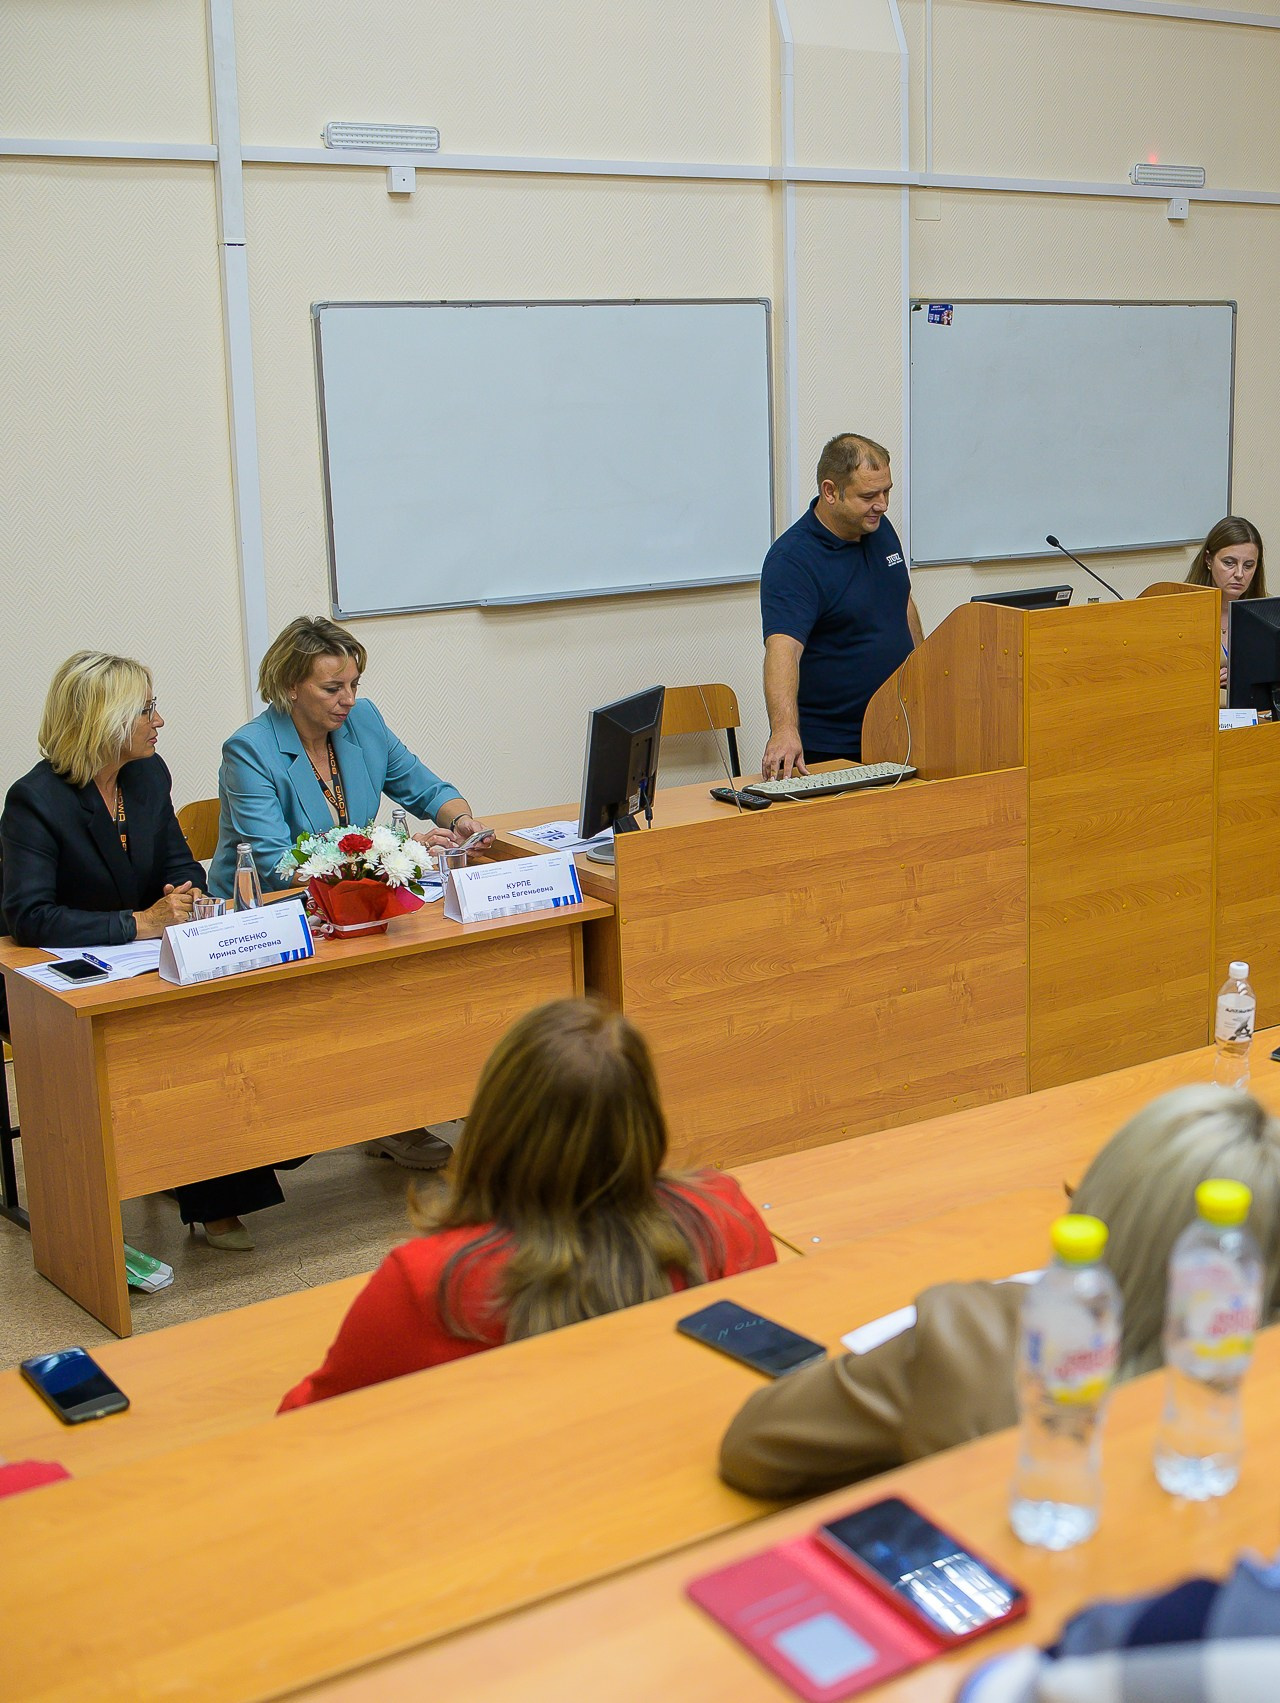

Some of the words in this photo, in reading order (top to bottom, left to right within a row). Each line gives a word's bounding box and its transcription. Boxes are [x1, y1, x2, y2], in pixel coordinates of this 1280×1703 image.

[506, 879, 532, 890] КУРПЕ
[487, 892, 511, 902] Елена
[512, 885, 554, 898] Евгеньевна
[182, 926, 199, 938] VIII
[218, 931, 268, 948] СЕРГИЕНКО
[208, 948, 237, 960] Ирина
[238, 938, 282, 954] Сергеевна
